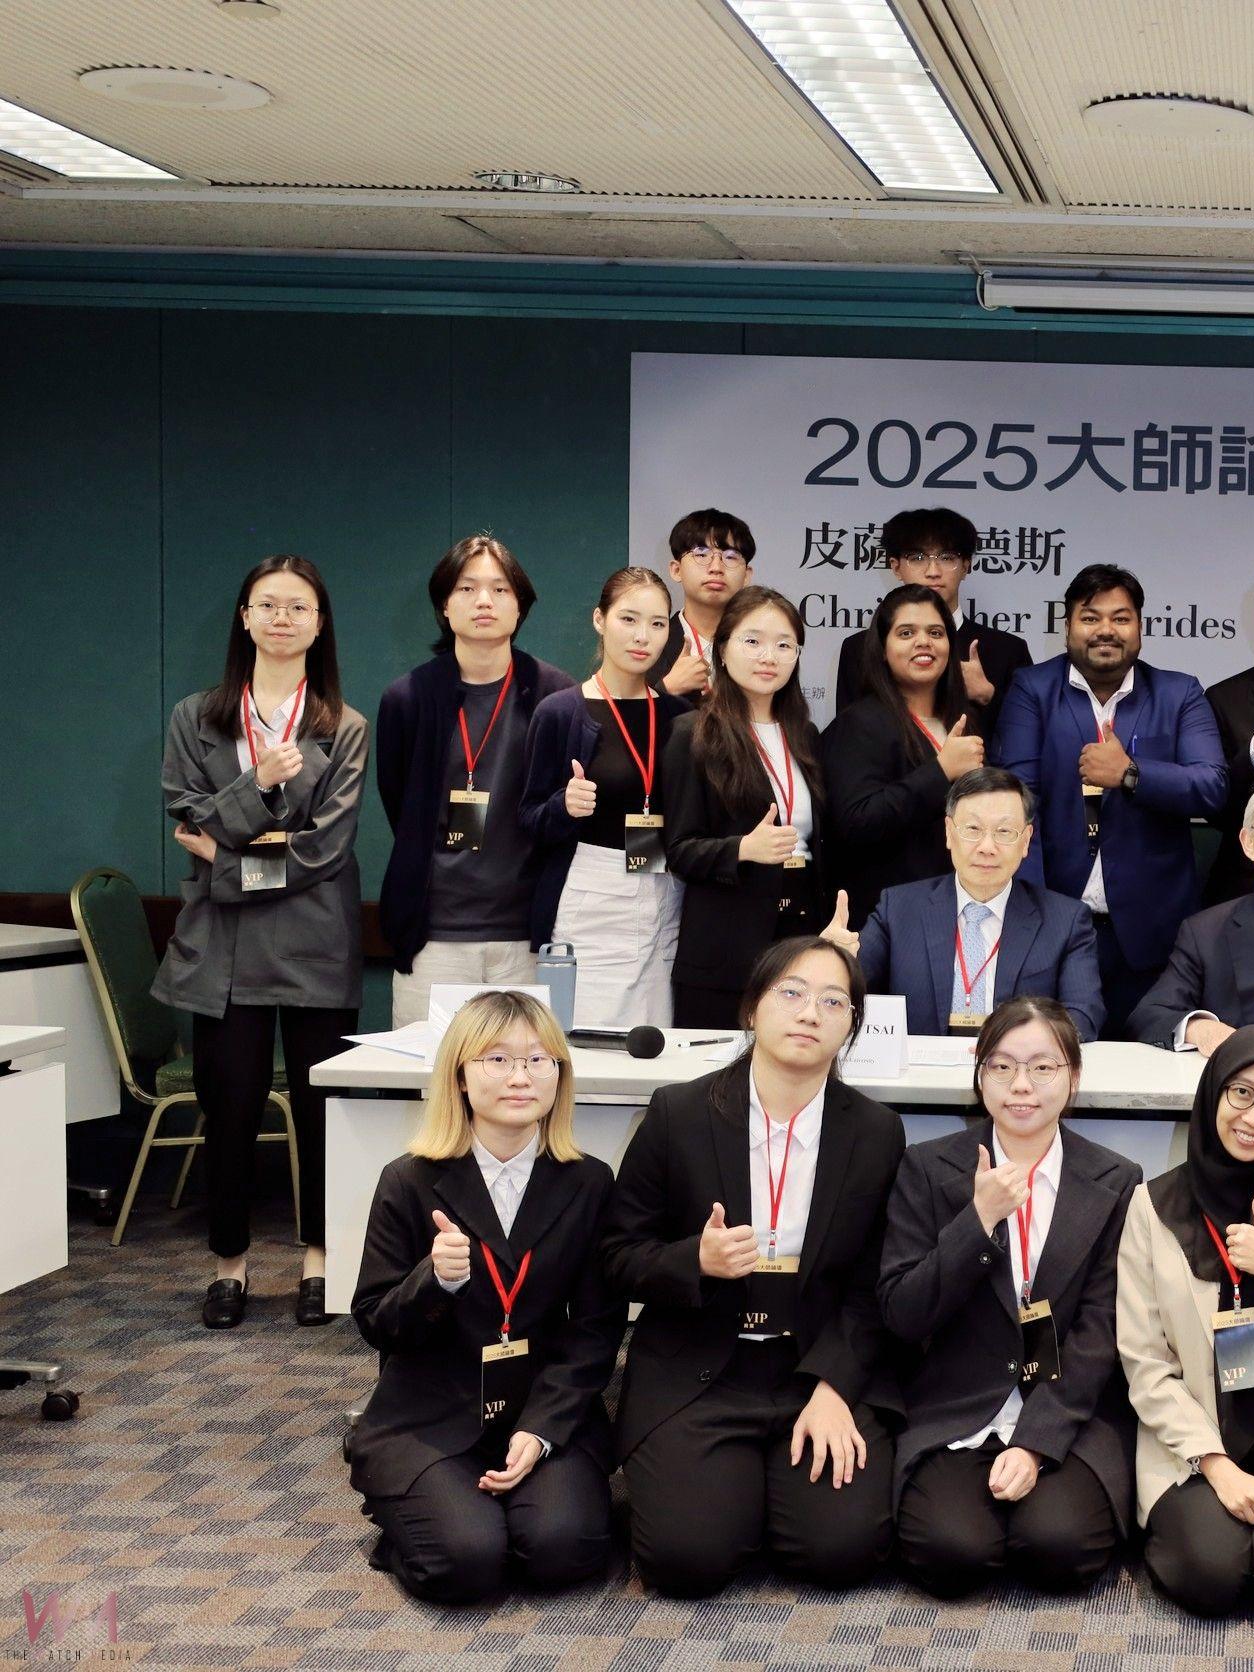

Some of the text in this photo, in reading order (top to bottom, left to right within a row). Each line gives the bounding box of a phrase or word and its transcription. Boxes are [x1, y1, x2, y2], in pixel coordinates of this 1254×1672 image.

[799, 521, 1066, 577] 皮薩德斯
[800, 593, 1236, 640] Chrher Prides
[449, 832, 464, 841] VIP
[629, 856, 647, 866] VIP
[864, 1024, 895, 1035] TSAI
[746, 1312, 768, 1323] VIP
[1022, 1361, 1039, 1375] VIP
[1222, 1367, 1246, 1380] VIP
[485, 1400, 506, 1413] VIP
